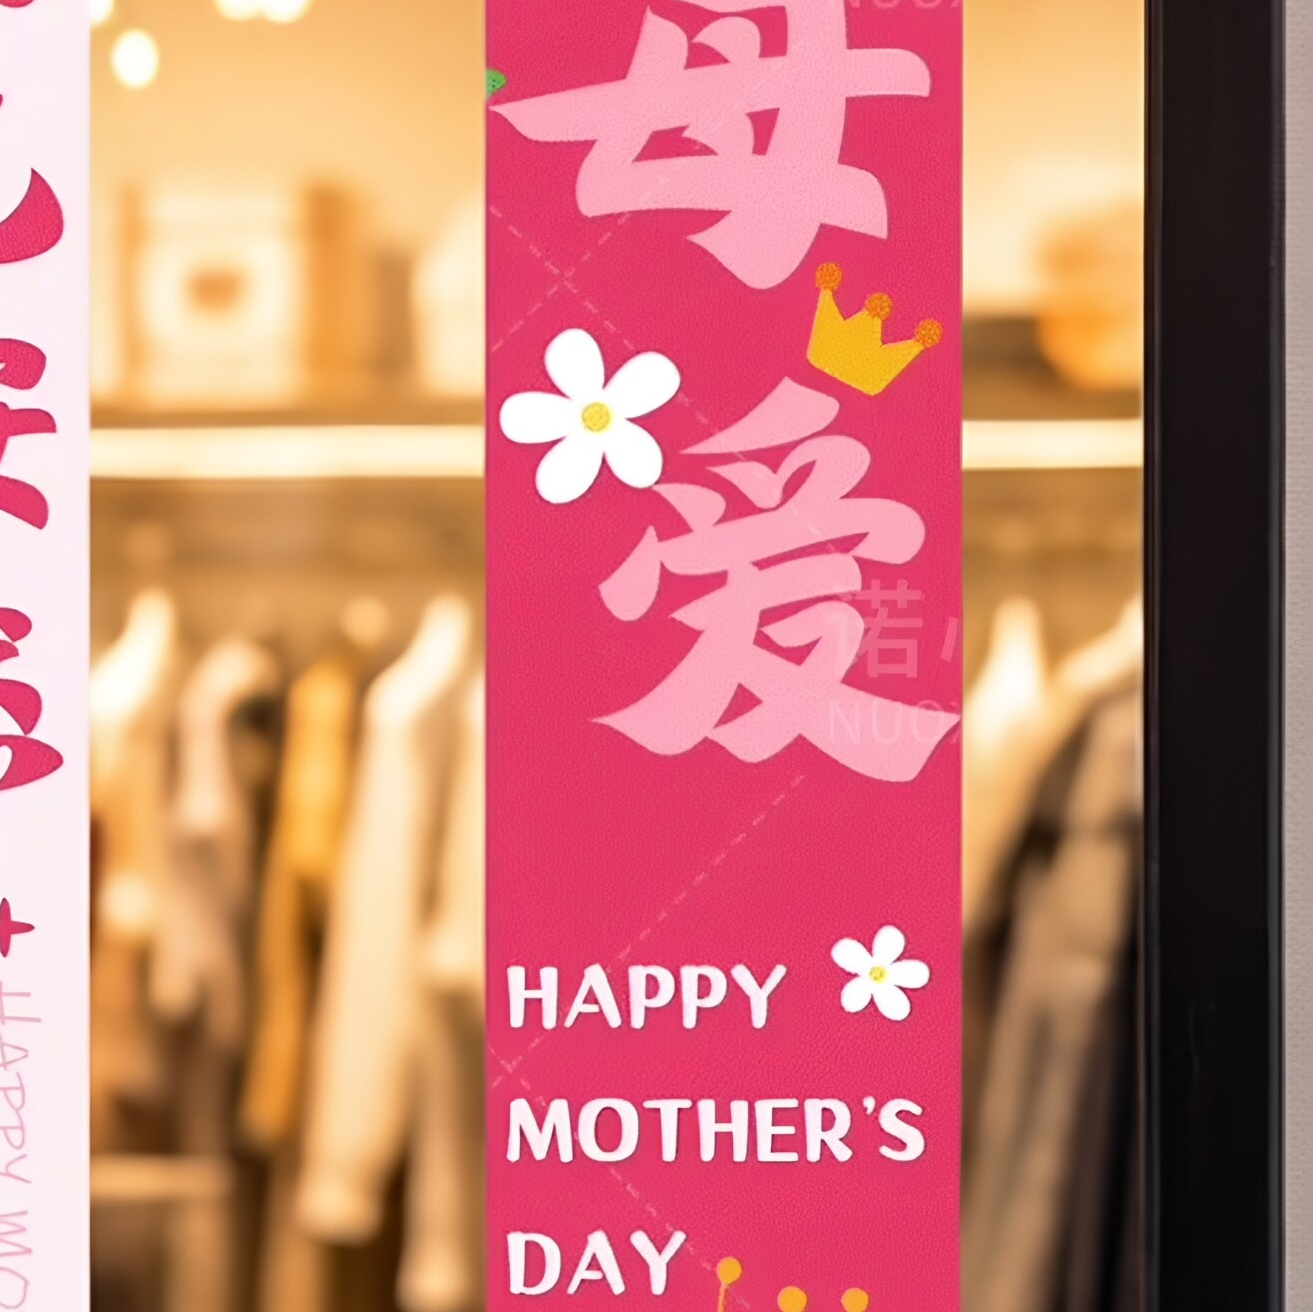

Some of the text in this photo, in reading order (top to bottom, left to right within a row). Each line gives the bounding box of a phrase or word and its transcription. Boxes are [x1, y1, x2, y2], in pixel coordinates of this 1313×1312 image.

[506, 962, 788, 1030] HAPPY
[505, 1095, 926, 1164] MOTHER'S
[506, 1229, 687, 1296] DAY
